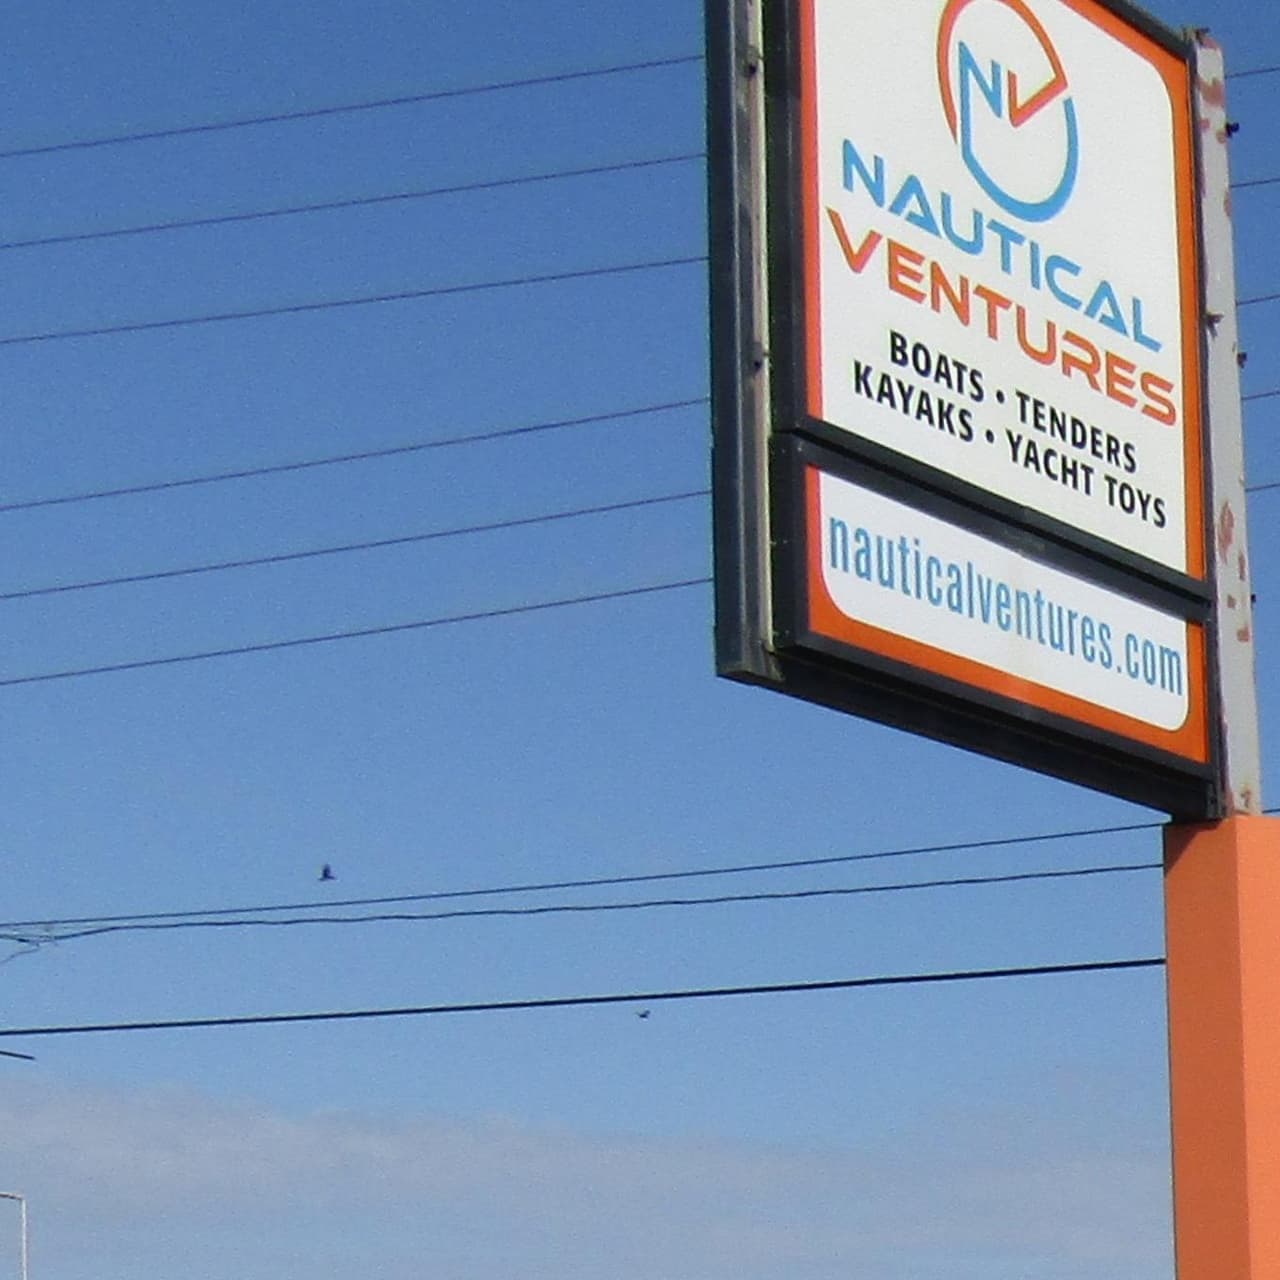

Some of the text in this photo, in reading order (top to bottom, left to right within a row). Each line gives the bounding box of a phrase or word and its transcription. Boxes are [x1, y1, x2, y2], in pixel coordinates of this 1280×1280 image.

[826, 207, 1177, 427] VENTURES
[842, 138, 1163, 353] NAUTICAL
[853, 359, 1168, 529] KAYAKS YACHT TOYS
[888, 329, 1137, 474] BOATS TENDERS
[829, 516, 1183, 697] nauticalventures.com
